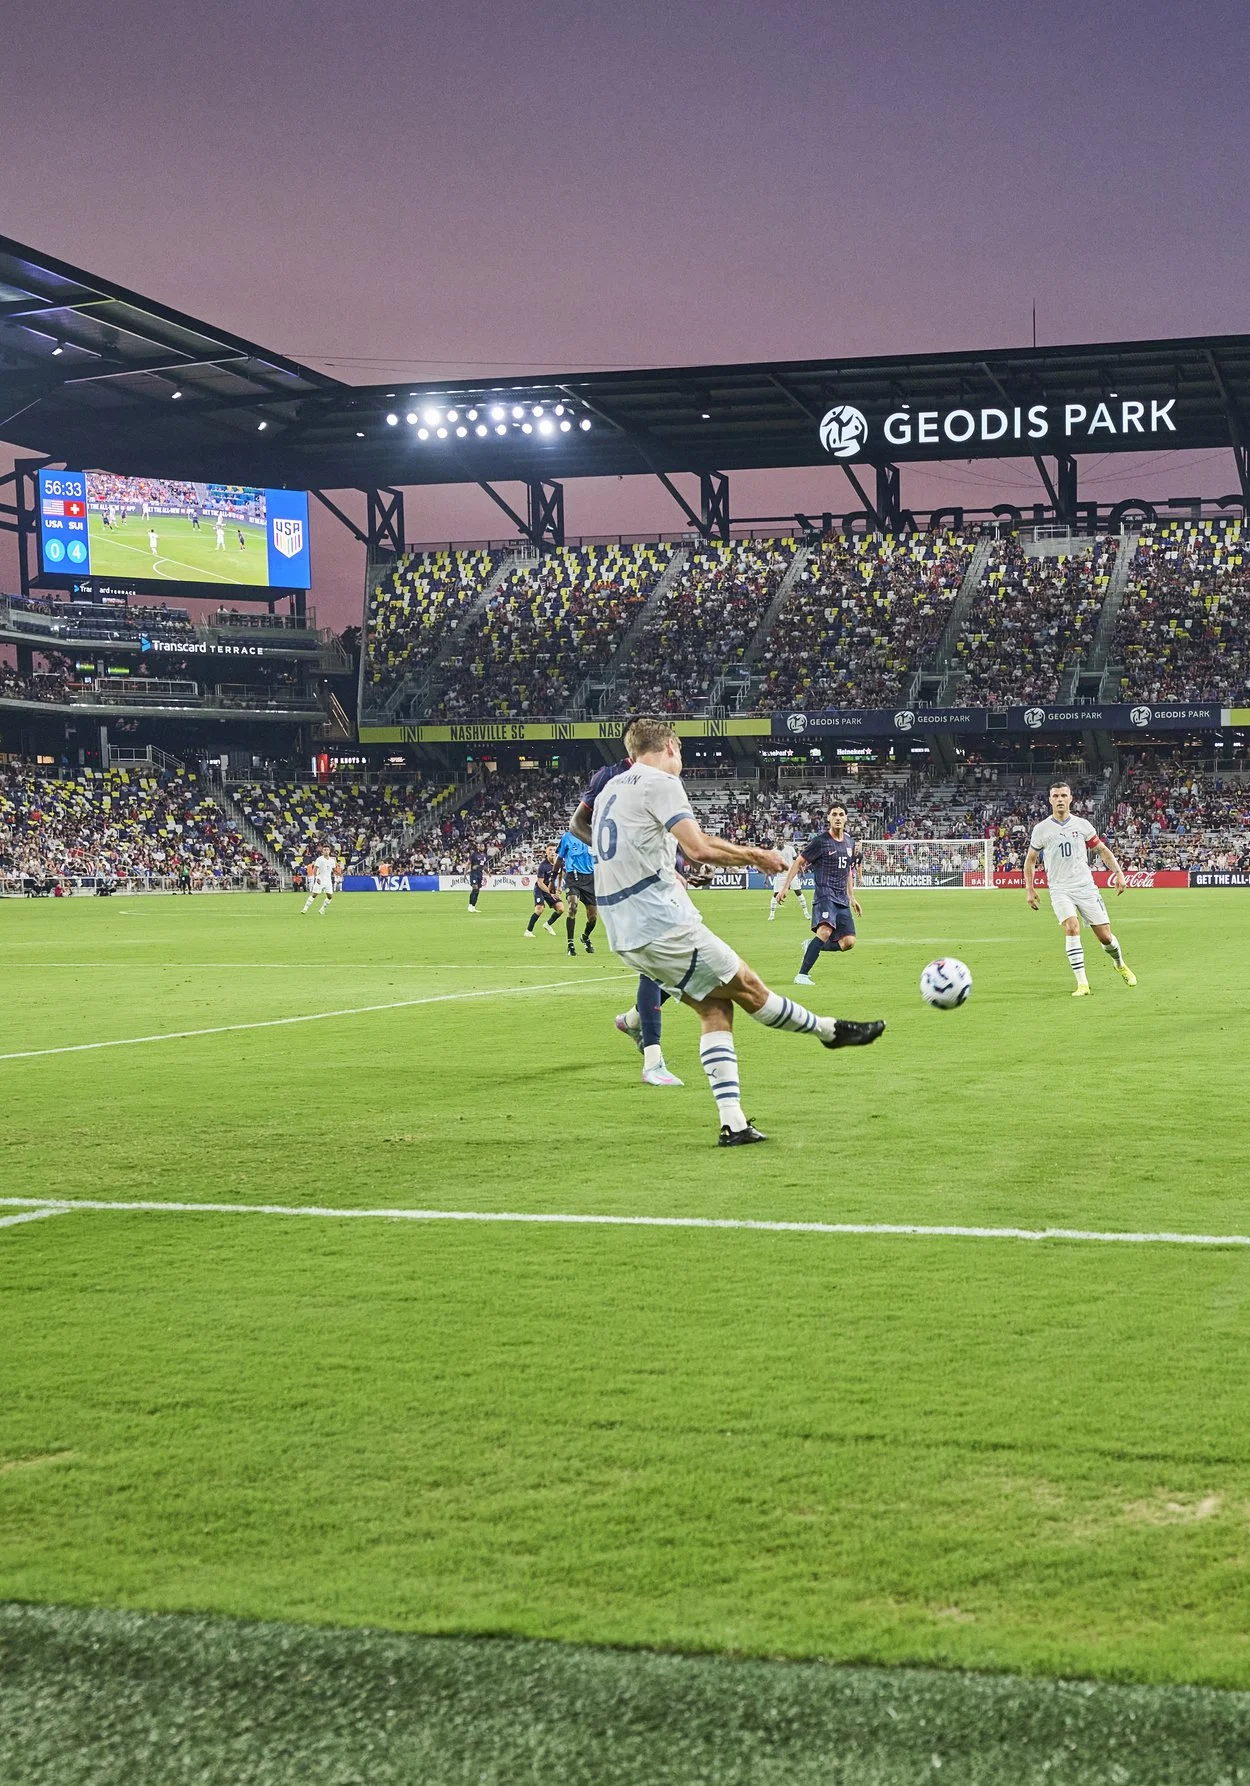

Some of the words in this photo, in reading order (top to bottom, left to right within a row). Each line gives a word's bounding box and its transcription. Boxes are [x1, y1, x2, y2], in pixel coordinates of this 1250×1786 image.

[884, 405, 1049, 445] GEODIS
[1065, 399, 1177, 437] PARK
[44, 479, 82, 497] 56:33
[45, 519, 63, 529] USA
[69, 521, 84, 531] SUI
[275, 520, 300, 536] USA
[50, 543, 60, 559] 0
[72, 544, 81, 560] 4
[152, 639, 207, 653] Transcard
[210, 645, 264, 656] TERRACE
[918, 715, 948, 723] GEODIS
[950, 714, 970, 722] PARK
[1048, 712, 1079, 720] GEODIS
[1081, 711, 1103, 720] PARK
[1155, 710, 1186, 719] GEODIS
[1188, 710, 1210, 718] PARK
[810, 718, 840, 726] GEODIS
[841, 717, 862, 725] PARK
[450, 724, 507, 741] NASHVILLE
[511, 724, 525, 740] SC
[1058, 841, 1072, 858] 10
[838, 856, 847, 869] 15
[371, 875, 411, 891] VISA
[492, 877, 503, 888] JIM
[503, 876, 517, 887] BEAM
[711, 874, 742, 886] TRULY
[861, 874, 932, 887] NIKE.COM/SOCCER
[1007, 878, 1045, 886] AMECA
[1196, 874, 1213, 885] GET
[1214, 874, 1230, 885] THE
